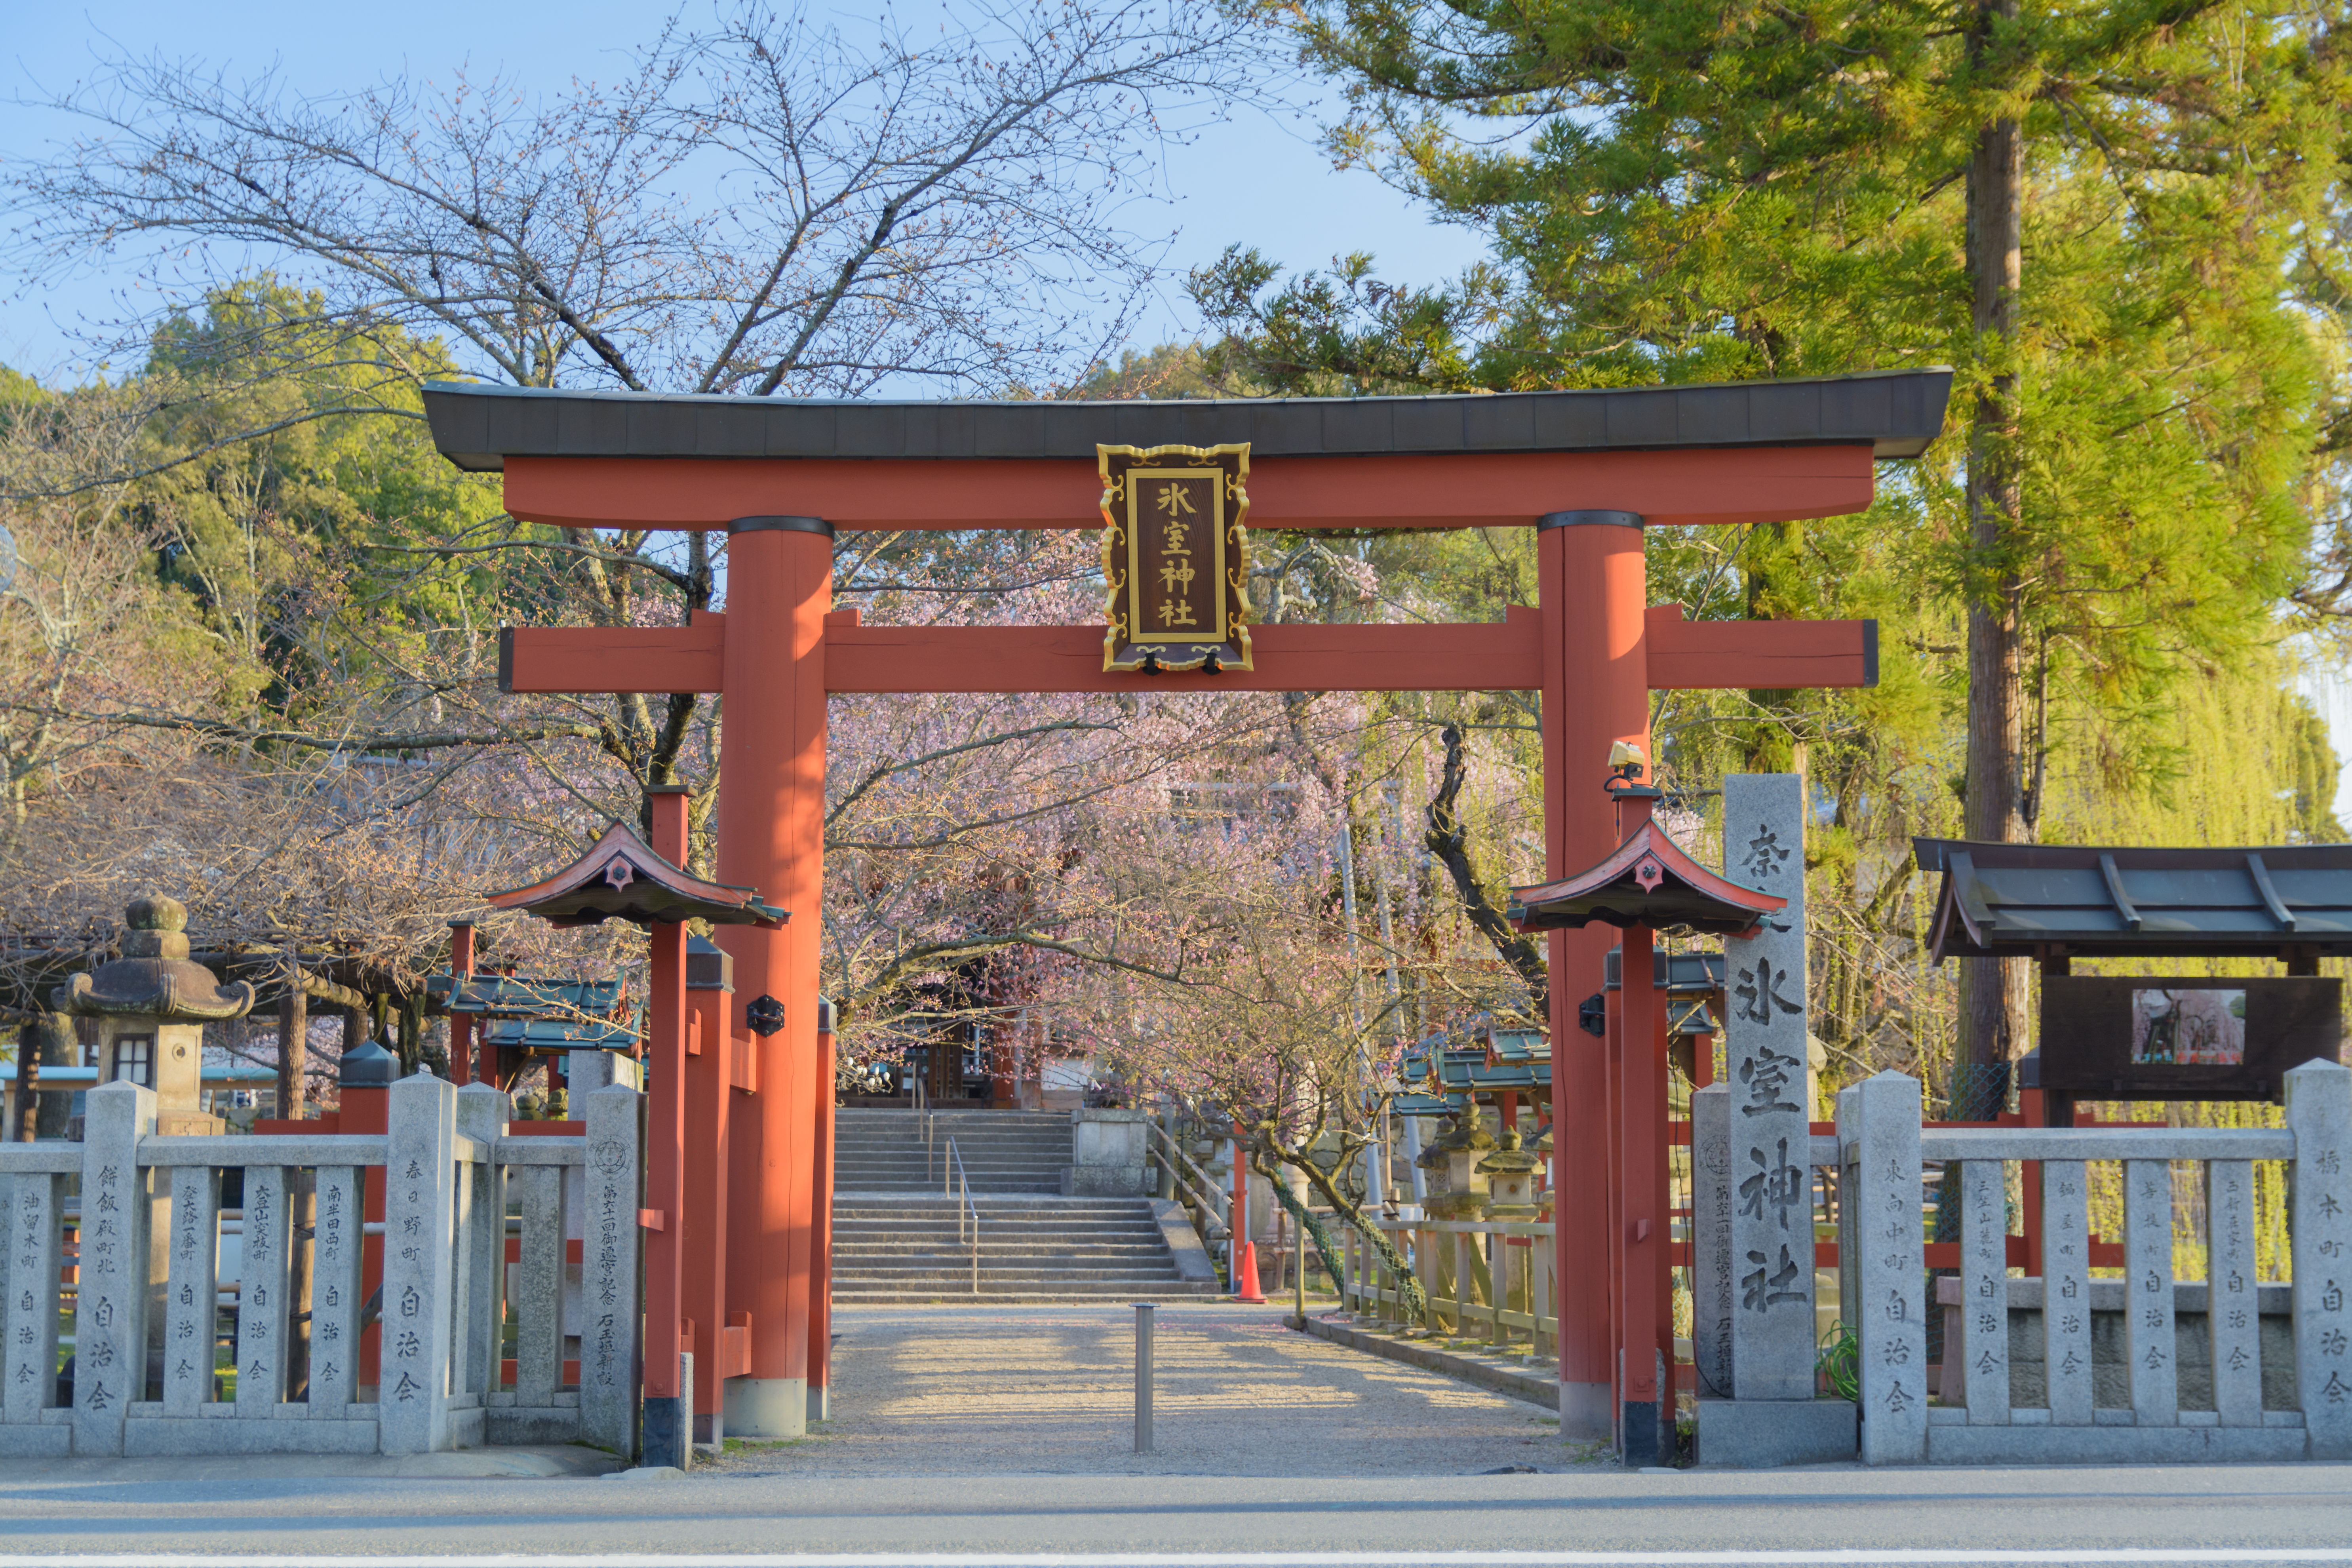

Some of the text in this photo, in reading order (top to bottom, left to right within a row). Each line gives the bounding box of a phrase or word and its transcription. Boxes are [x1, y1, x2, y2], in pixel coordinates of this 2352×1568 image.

[1157, 483, 1197, 627] 氷室神社
[1736, 824, 1807, 1313] 奈氷室神社
[321, 1185, 341, 1382] 南半田西町自治会
[394, 1159, 422, 1402] 春日野町自治会
[1884, 1159, 1915, 1413] 東向中町自治会
[2316, 1150, 2351, 1403] 橋本町自治会
